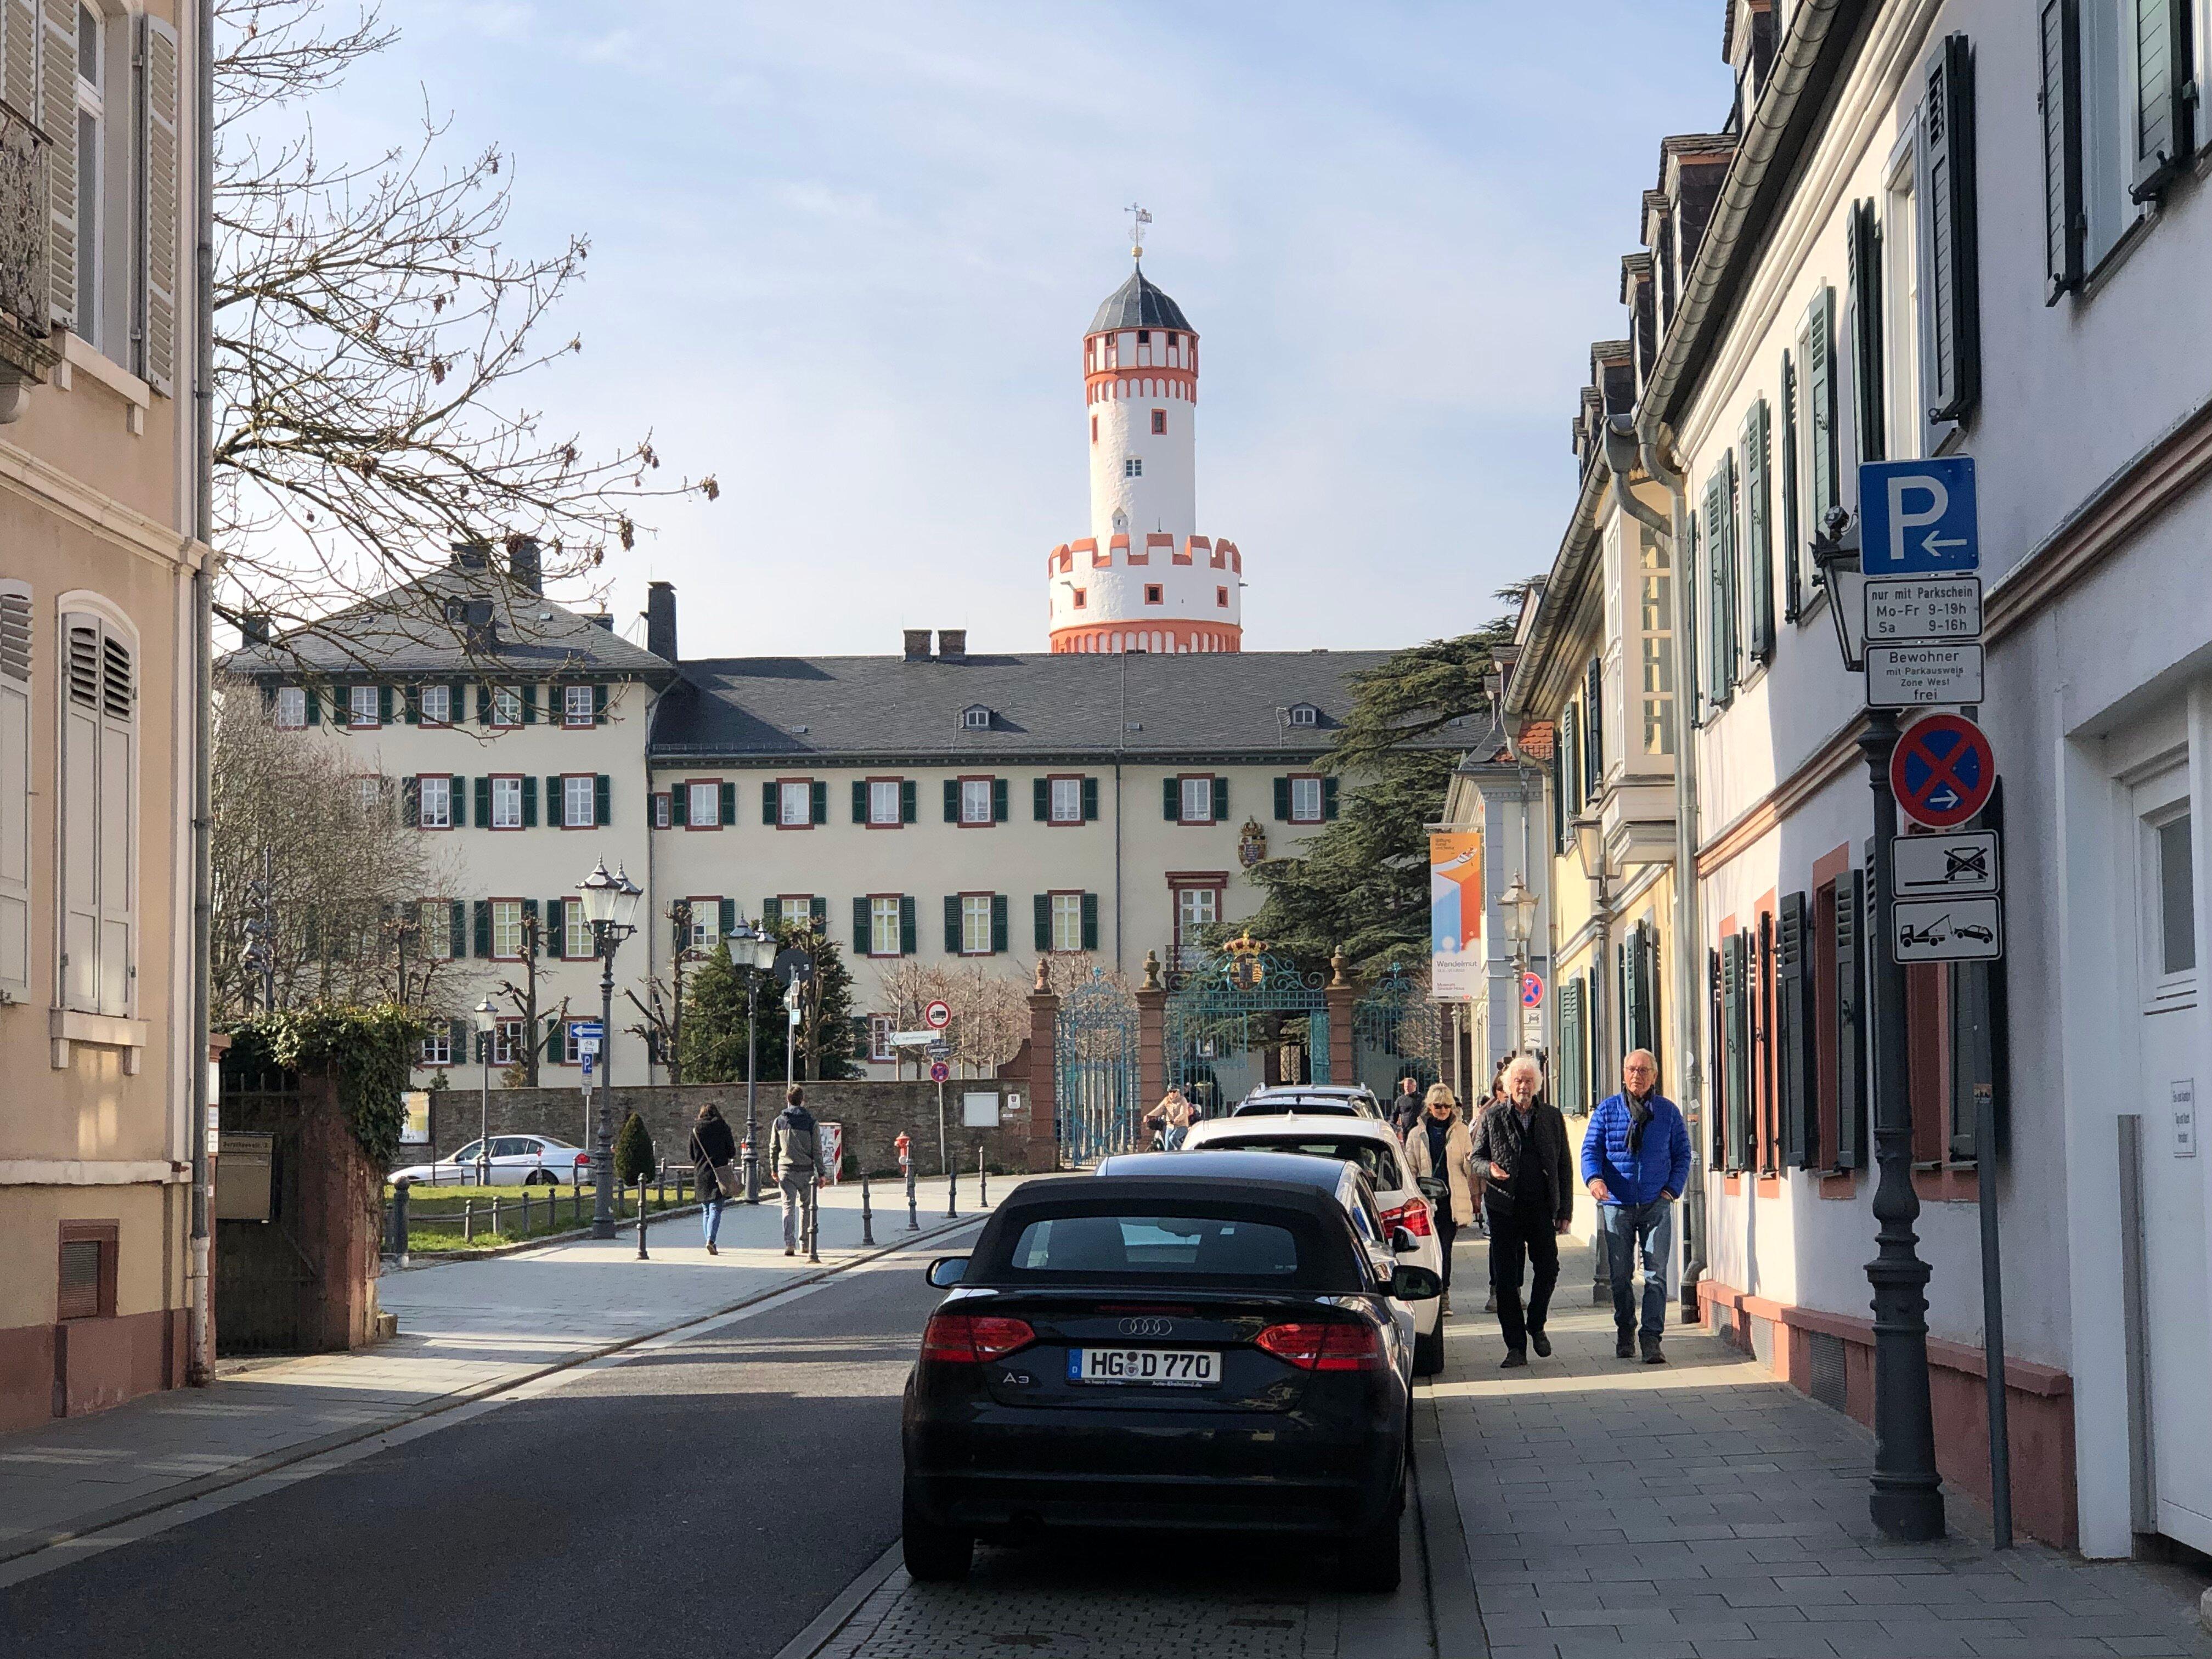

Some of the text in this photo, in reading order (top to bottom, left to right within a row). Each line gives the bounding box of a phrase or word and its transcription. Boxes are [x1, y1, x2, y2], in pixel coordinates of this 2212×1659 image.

[1887, 475, 1949, 560] P
[1871, 585, 1973, 601] nur mit Parkschein
[1876, 602, 1967, 617] Mo-Fr 9-19h
[1878, 618, 1967, 633] Sa 9-16h
[1889, 651, 1960, 663] Bewohner
[1886, 665, 1964, 676] mit Parkausweis
[1900, 679, 1923, 687] Zone
[1914, 688, 1937, 701] frei
[584, 1056, 591, 1071] P
[1091, 1352, 1124, 1376] HG
[1163, 1354, 1211, 1379] 770
[1002, 1372, 1030, 1384] A3
